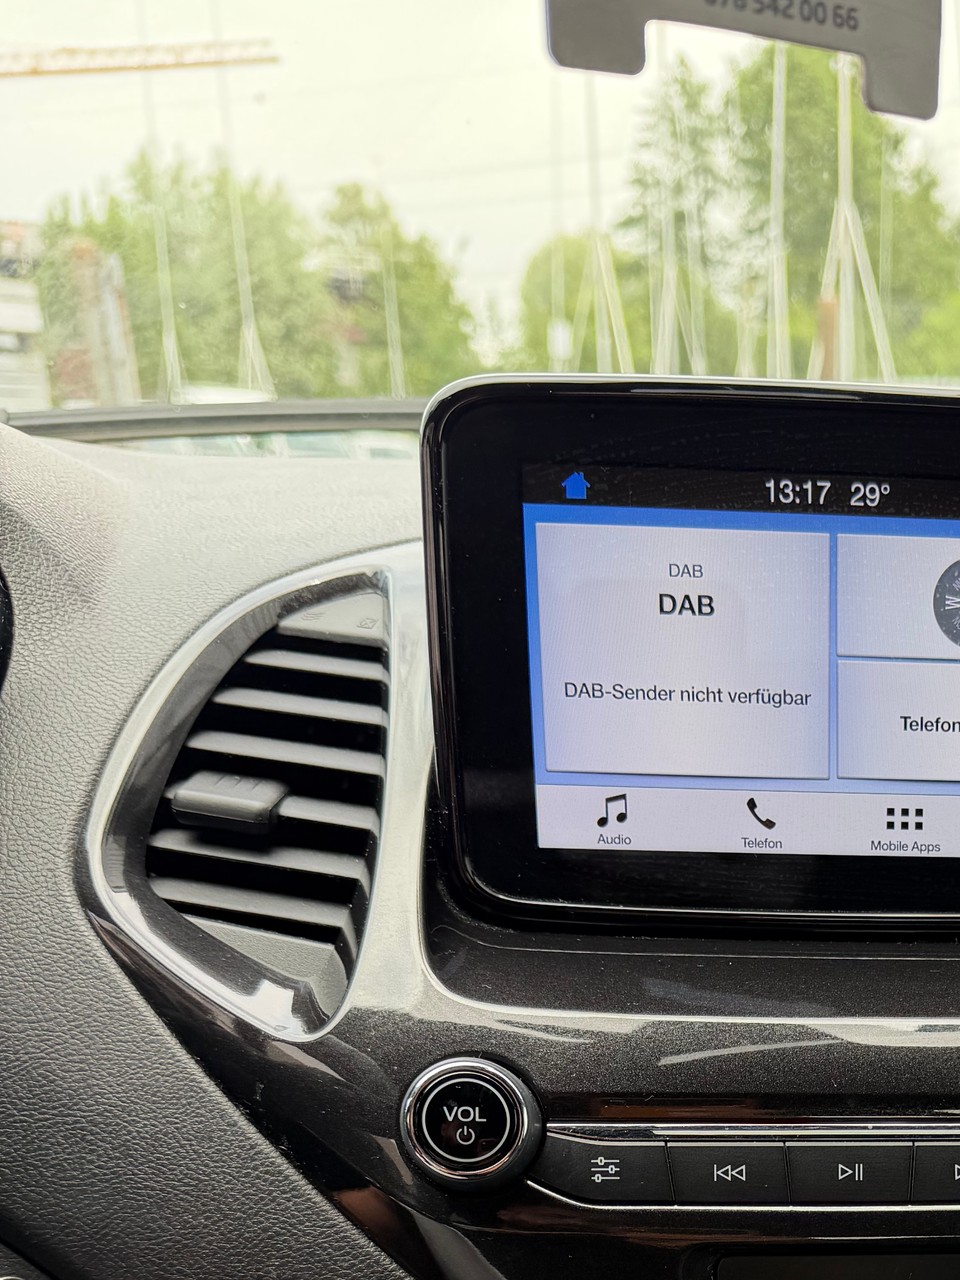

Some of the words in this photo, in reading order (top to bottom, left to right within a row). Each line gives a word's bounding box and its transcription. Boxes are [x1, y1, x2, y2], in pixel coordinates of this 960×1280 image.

[799, 1, 827, 24] 00
[832, 5, 859, 31] 66
[765, 478, 831, 506] 13:17
[849, 483, 891, 507] 29°
[668, 563, 704, 579] DAB
[658, 593, 715, 617] DAB
[564, 682, 676, 702] DAB-Sender
[680, 687, 723, 704] nicht
[728, 688, 812, 709] verfügbar
[597, 833, 632, 846] Audio
[741, 836, 783, 850] Telefon
[870, 840, 908, 853] Mobile
[911, 842, 942, 855] Apps
[442, 1106, 487, 1122] VOL
